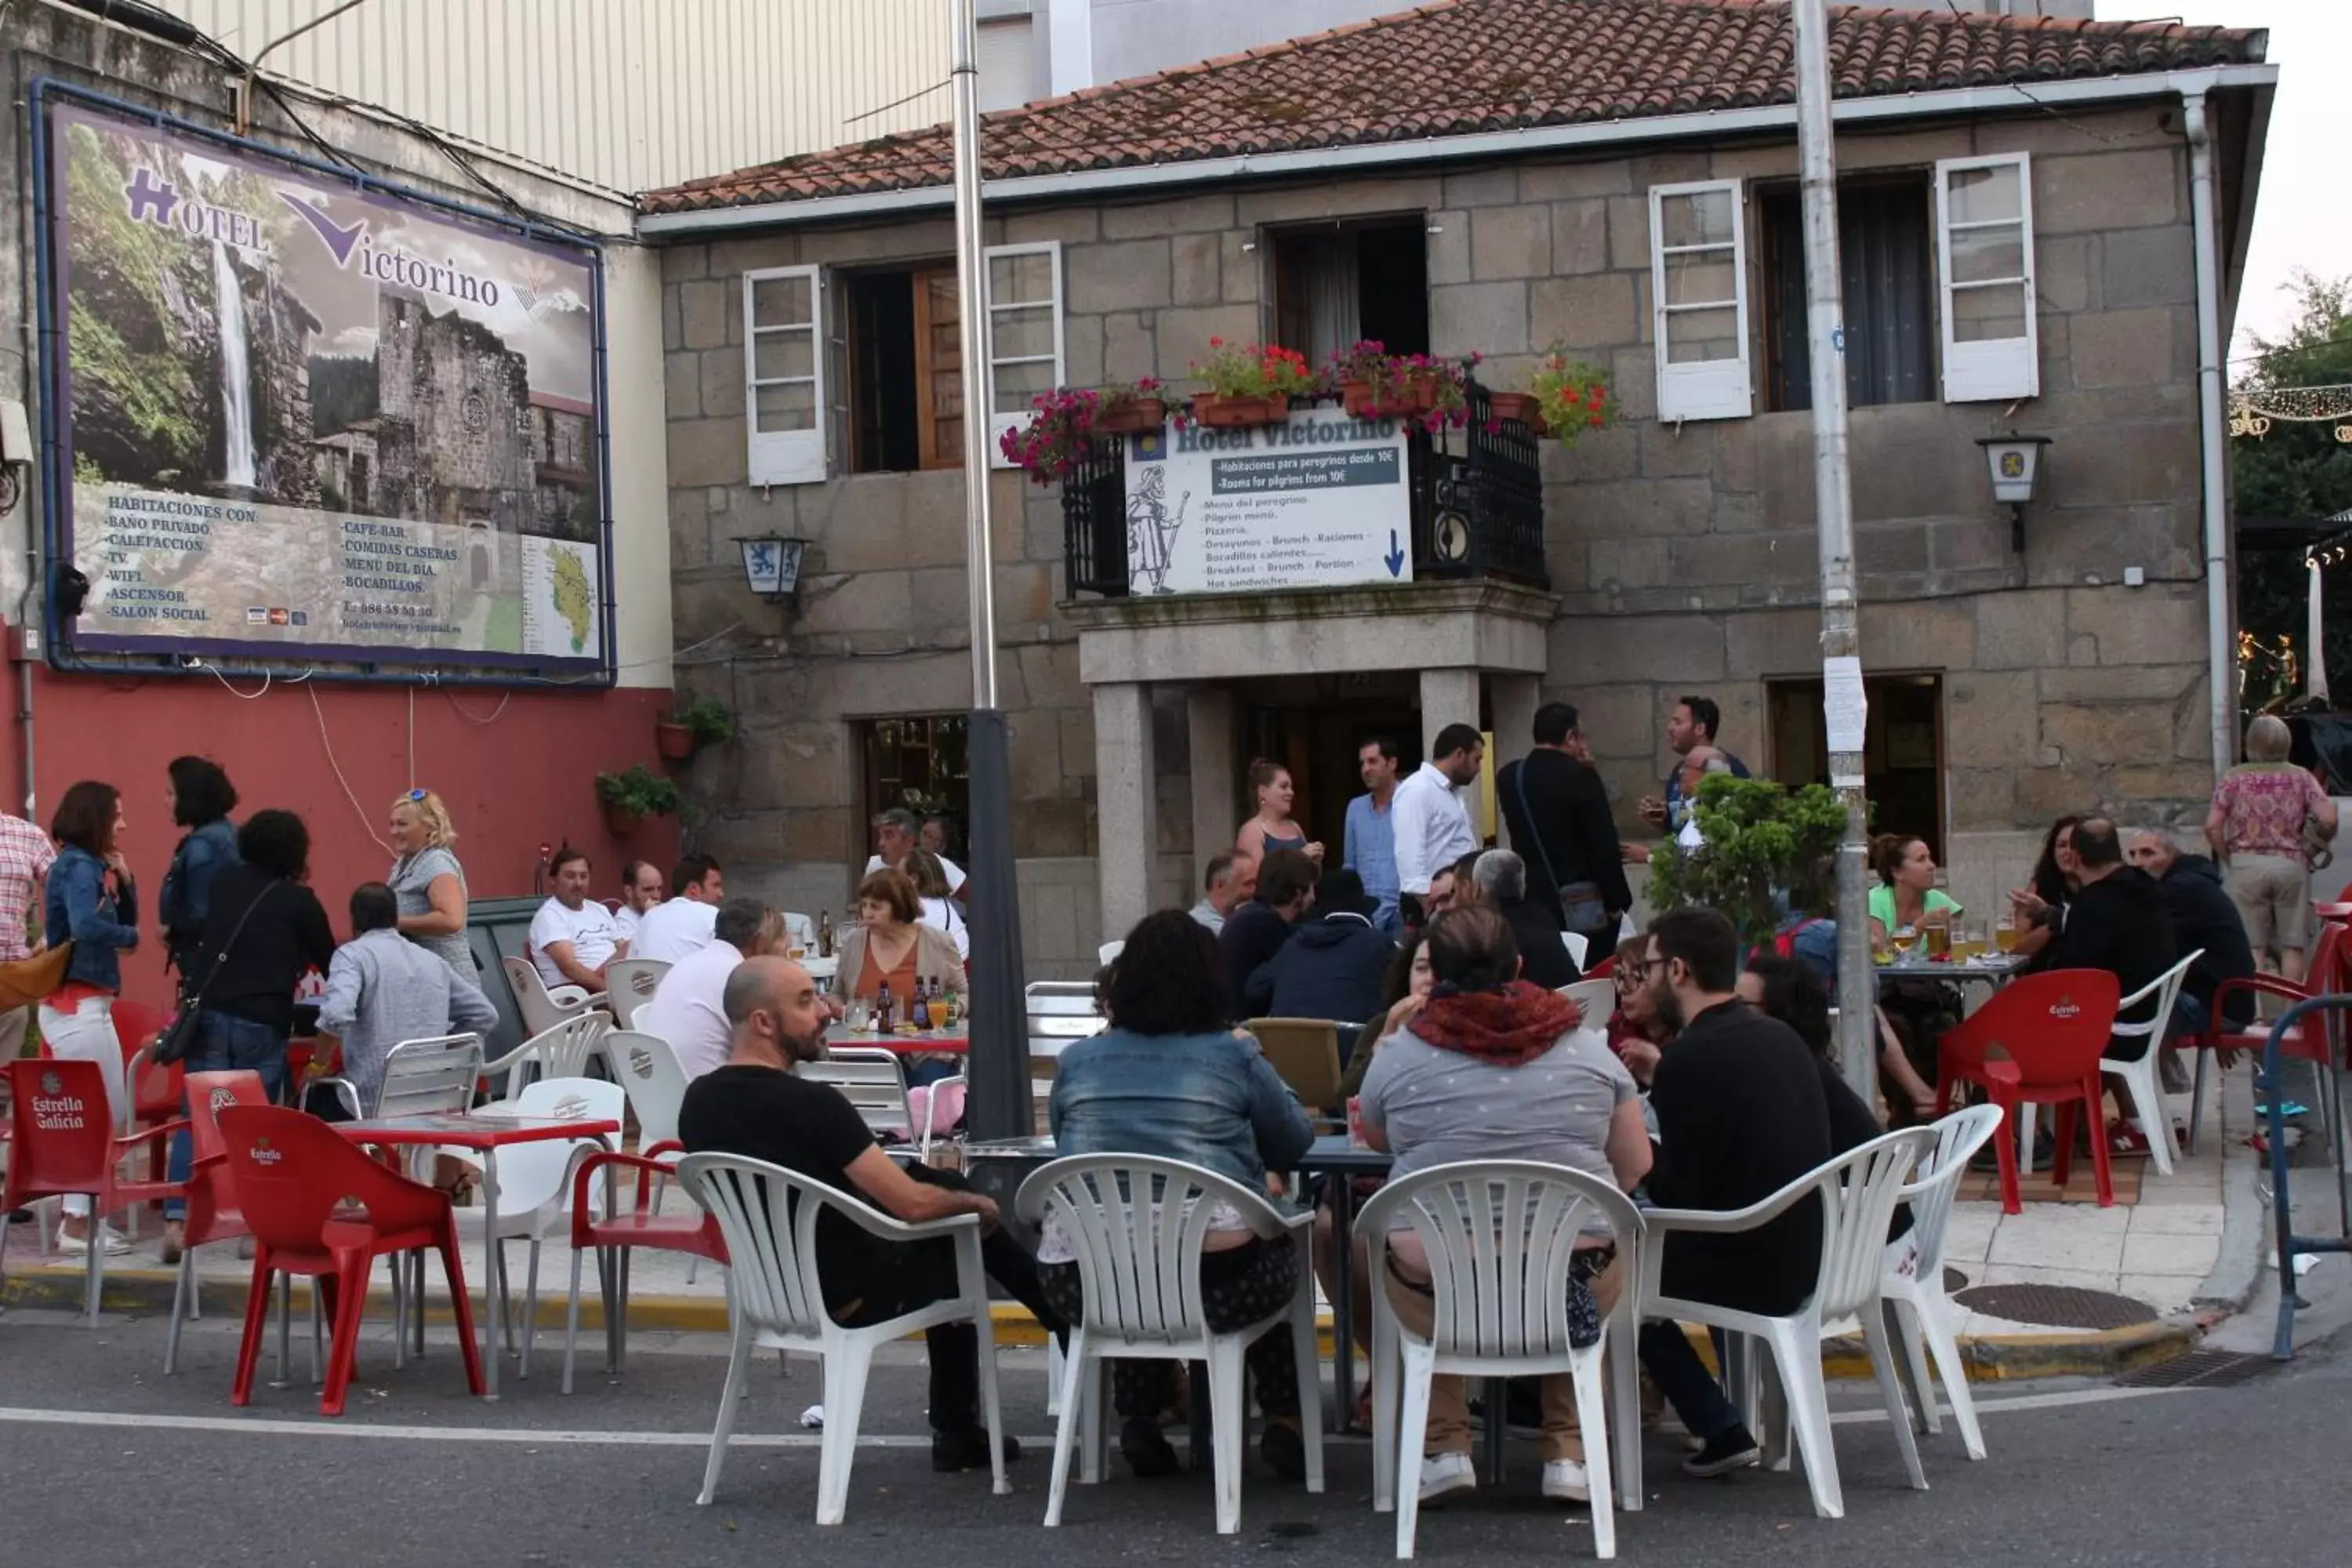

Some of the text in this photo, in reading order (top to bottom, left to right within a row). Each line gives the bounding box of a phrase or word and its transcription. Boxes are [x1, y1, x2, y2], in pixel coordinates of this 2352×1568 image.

[125, 167, 499, 307] HOTEL Victorino
[1177, 417, 1396, 452] Hotel Victorino
[1278, 458, 1298, 470] para
[1300, 456, 1347, 470] peregrinos
[1349, 452, 1374, 464] desde
[1377, 450, 1394, 463] 10€
[1252, 476, 1267, 488] for
[1268, 474, 1304, 488] pilgrims
[1305, 472, 1327, 484] from
[1330, 470, 1347, 482] 10€
[108, 495, 223, 519] HABITACIONES
[1236, 497, 1254, 509] del
[1272, 534, 1310, 546] Brunch
[1205, 551, 1257, 563] Bocadillos
[386, 561, 411, 575] DEL
[1267, 561, 1305, 573] Brunch
[1315, 559, 1355, 570] Portion
[1206, 576, 1289, 589] Hot sandwiches
[31, 1095, 84, 1112] Estrella
[37, 1112, 85, 1130] Galicia
